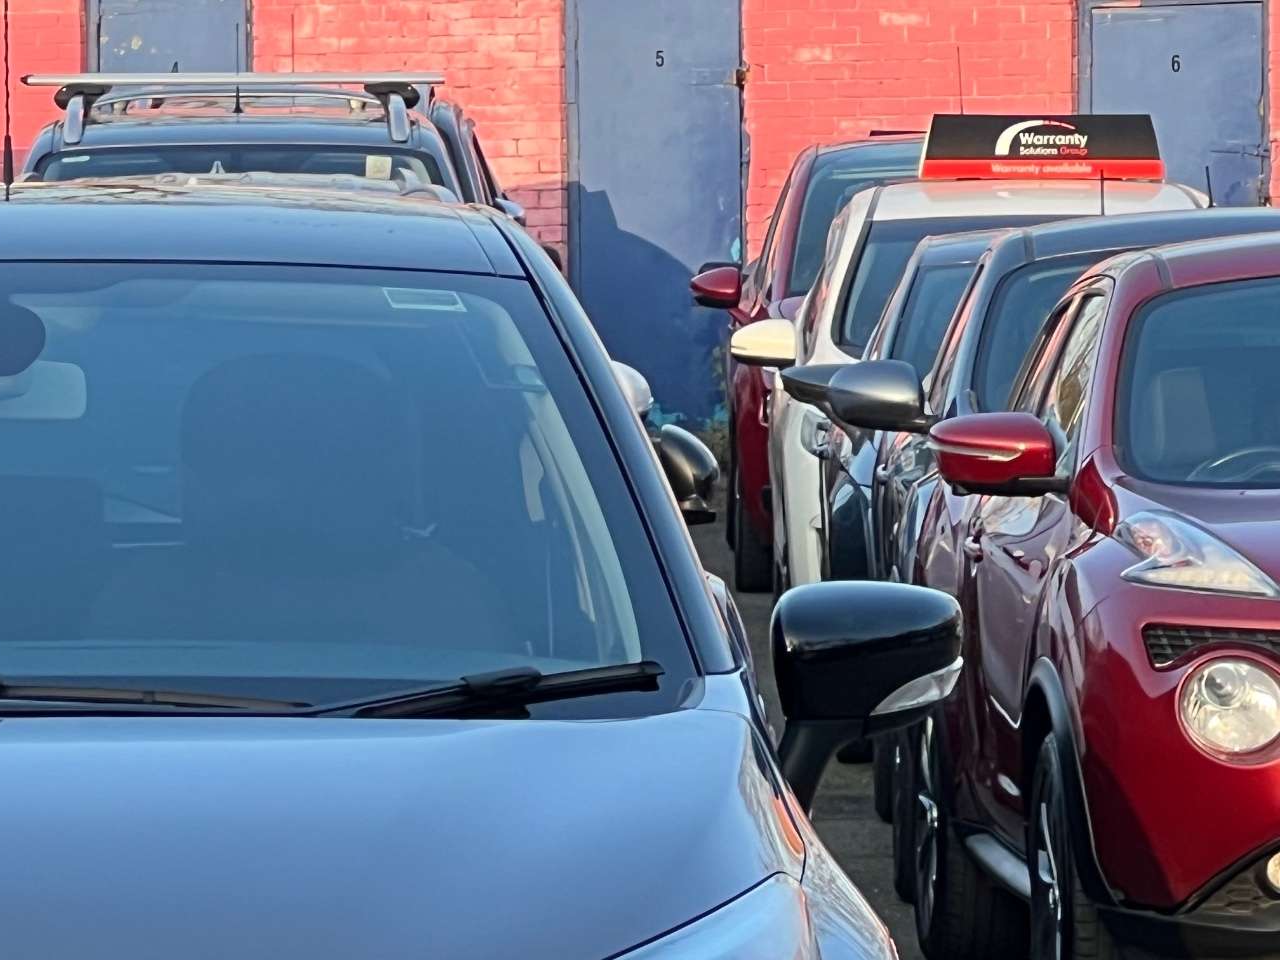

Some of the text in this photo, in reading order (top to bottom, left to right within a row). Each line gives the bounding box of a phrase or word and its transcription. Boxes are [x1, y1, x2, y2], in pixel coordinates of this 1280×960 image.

[655, 50, 665, 67] 5
[1171, 54, 1181, 73] 6
[1019, 132, 1088, 148] Warranty
